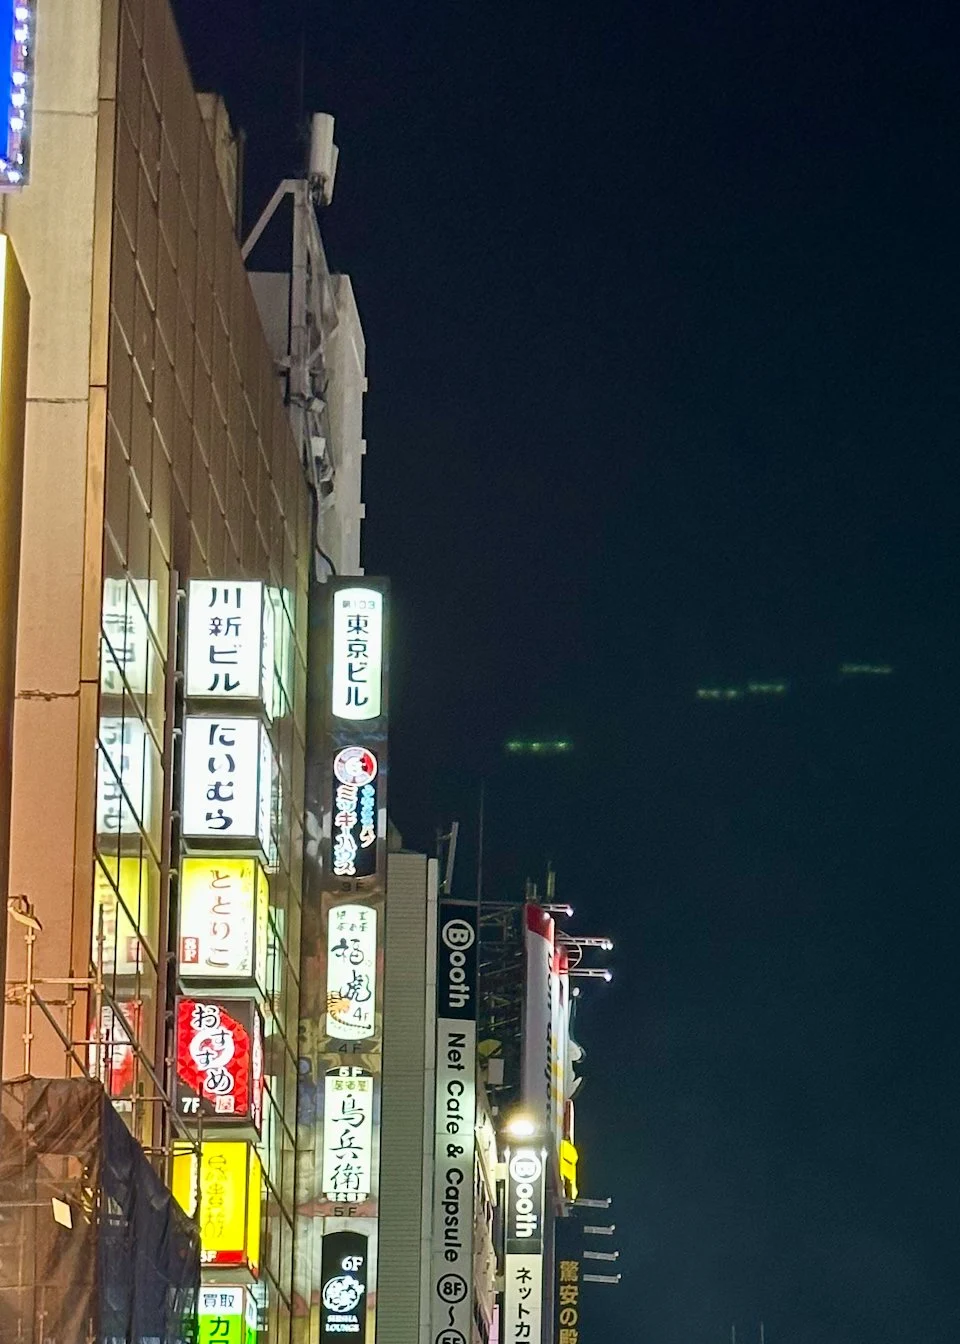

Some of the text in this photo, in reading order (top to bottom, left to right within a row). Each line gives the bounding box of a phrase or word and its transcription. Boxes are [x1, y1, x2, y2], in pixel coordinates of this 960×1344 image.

[208, 586, 242, 691] 川新ビル
[346, 614, 368, 706] 東京ビル
[206, 723, 236, 830] にいむら
[206, 870, 232, 969] ととりこ
[442, 919, 475, 1009] Booth
[352, 1006, 369, 1021] 4F
[182, 1097, 200, 1113] 7F
[444, 1032, 466, 1264] Net Cafe & Capsule
[509, 1152, 541, 1238] Booth
[203, 1293, 234, 1309] 買取
[342, 1256, 363, 1270] 6F
